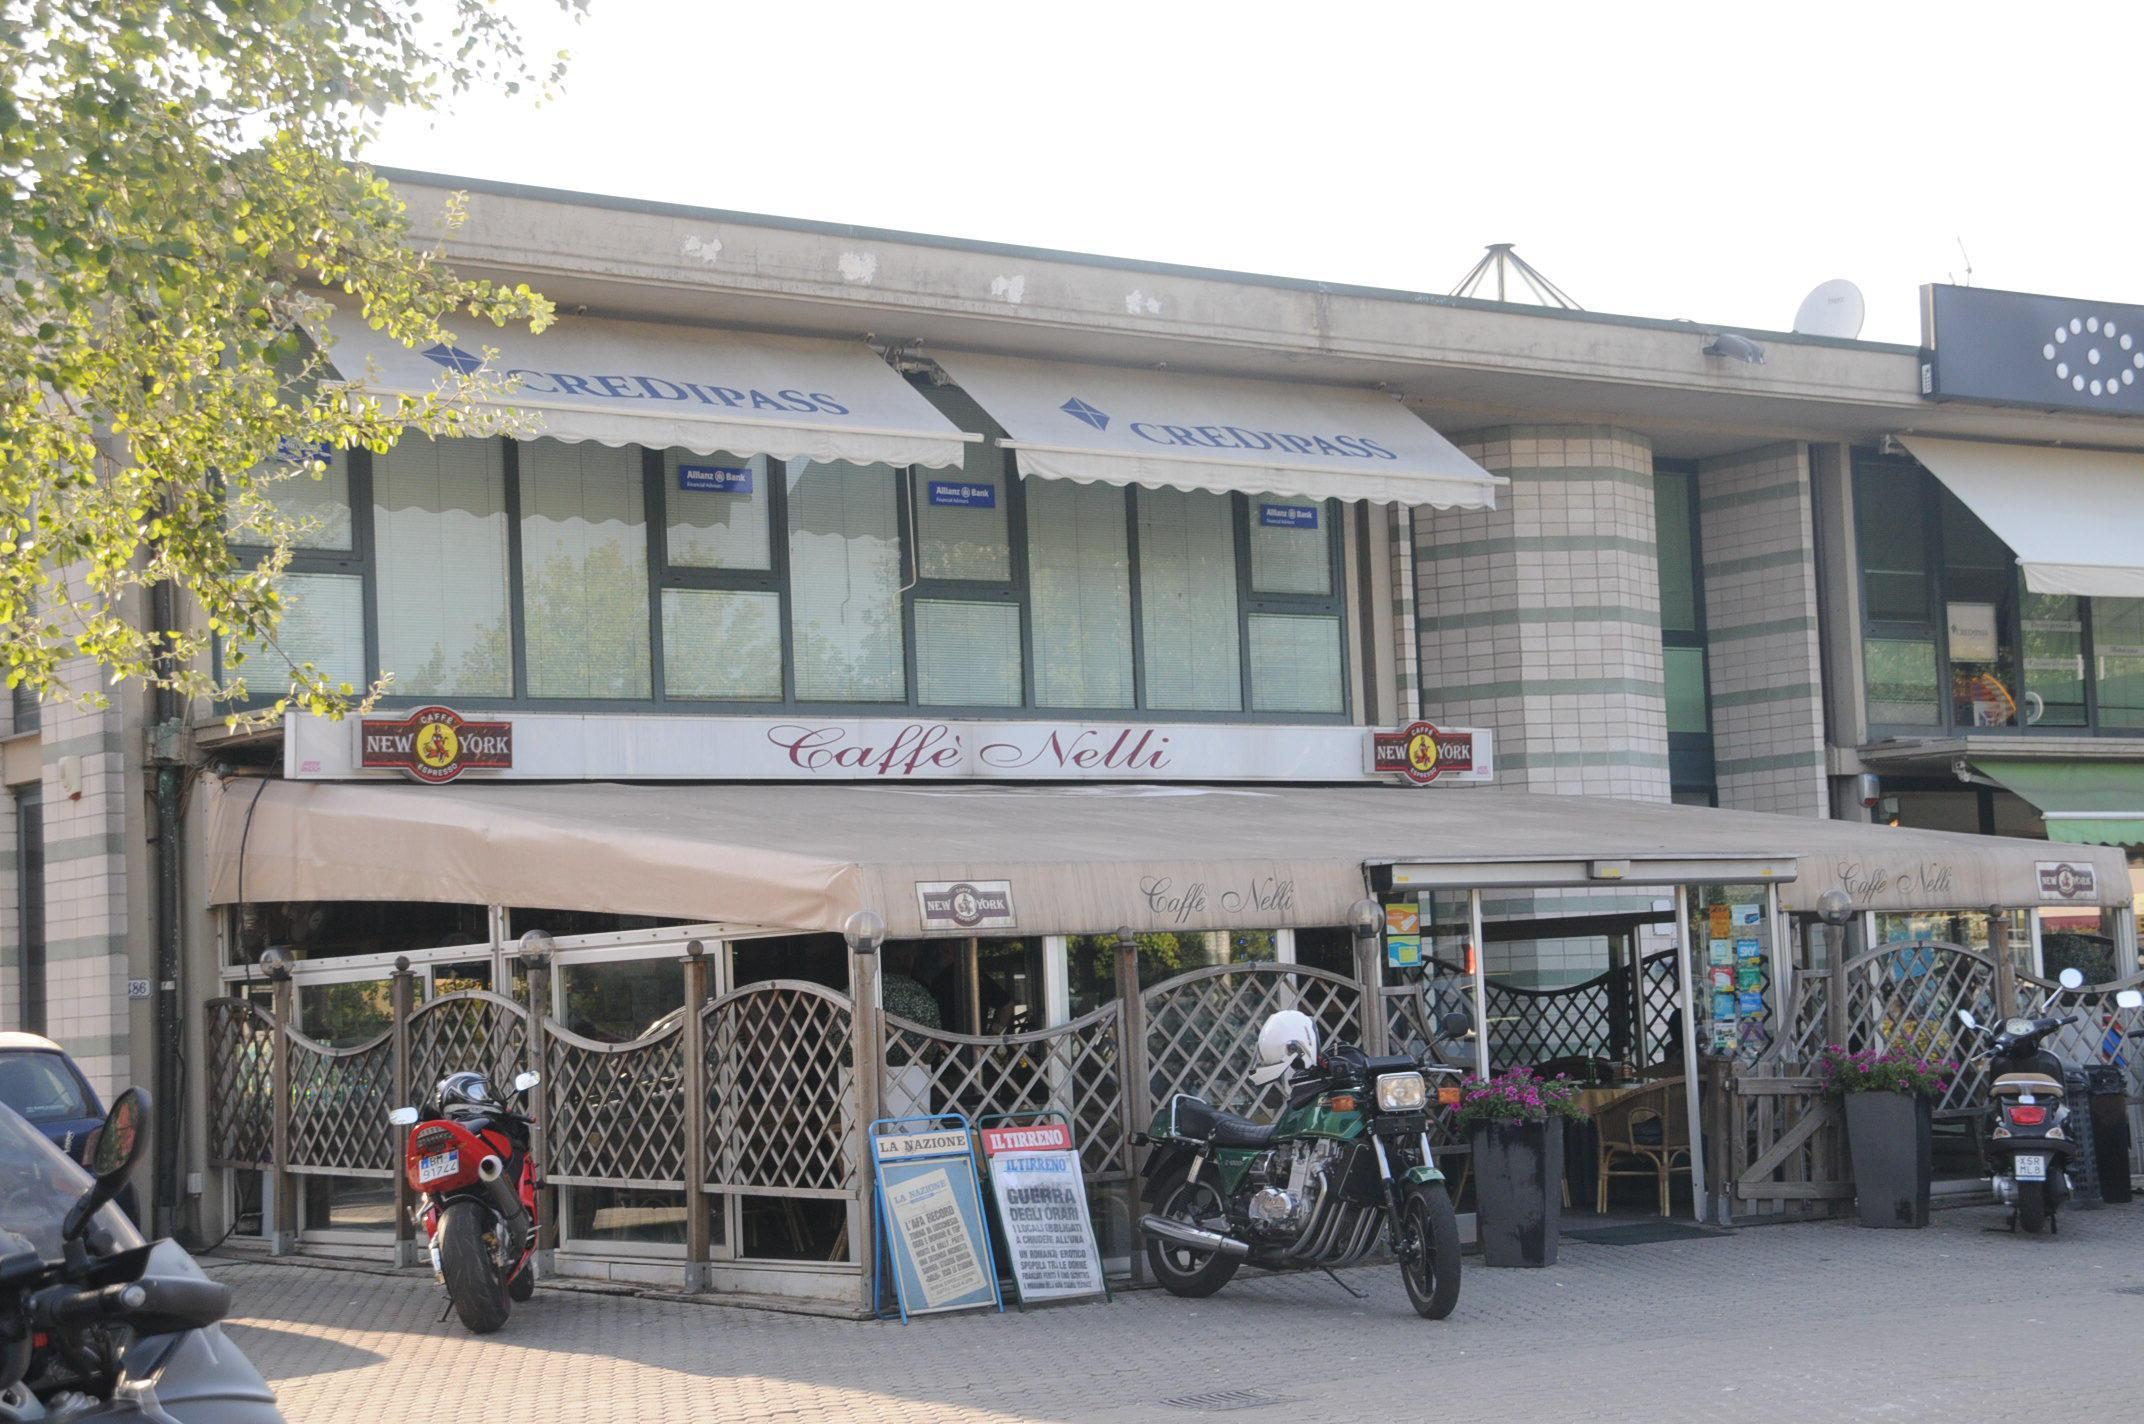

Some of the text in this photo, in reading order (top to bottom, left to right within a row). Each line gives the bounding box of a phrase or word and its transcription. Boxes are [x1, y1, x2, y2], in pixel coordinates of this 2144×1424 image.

[506, 369, 850, 415] CREDIPASS
[1130, 422, 1398, 460] CREDIPASS
[686, 470, 746, 482] Allianz Bank
[936, 486, 989, 497] Allianz Bank
[1266, 508, 1313, 519] Allianz Bank
[367, 733, 509, 754] NEW YORK
[767, 724, 1172, 775] Caffè Nelli
[1377, 742, 1471, 760] NEW YORK
[417, 762, 458, 777] ESPRESSO
[1896, 862, 1952, 895] Nelli
[2040, 875, 2058, 886] NEW
[927, 898, 1006, 911] NEW YORK
[1139, 875, 1295, 923] Caffè Nelli
[880, 1135, 966, 1153] LA NAZIONE
[990, 1129, 1064, 1150] IL TIRRENO
[1006, 1157, 1067, 1172] IL TIRRENO
[894, 1193, 908, 1204] LA
[909, 1179, 947, 1197] NAZIONE
[1007, 1187, 1077, 1205] GUERRA
[925, 1204, 956, 1224] RECORD
[1009, 1206, 1080, 1222] DEGLI ORARI
[1018, 1223, 1044, 1233] LOCALI
[1044, 1223, 1083, 1233] OBBLIGATI
[1022, 1234, 1054, 1244] CHIUDERE
[1055, 1234, 1084, 1244] ALL'UNA
[1060, 1248, 1087, 1259] EROTICO
